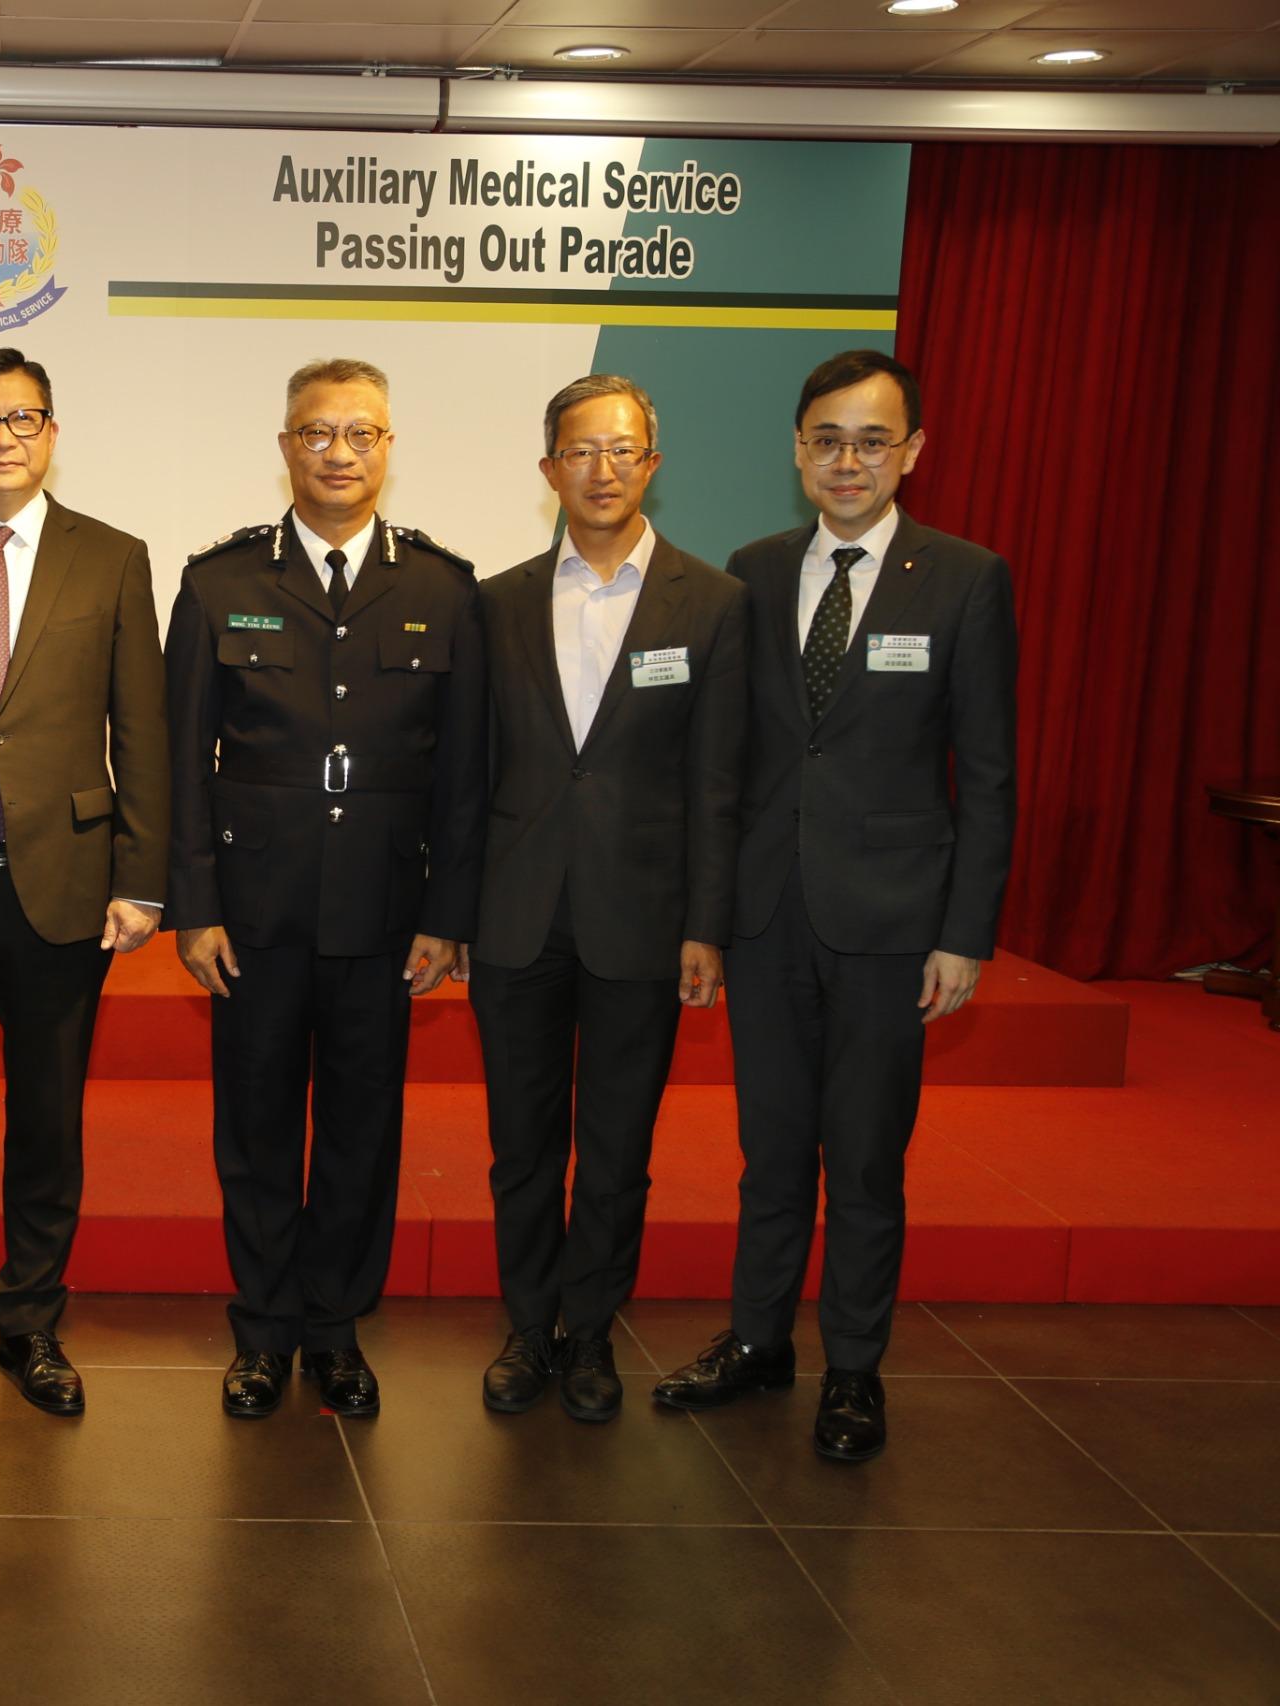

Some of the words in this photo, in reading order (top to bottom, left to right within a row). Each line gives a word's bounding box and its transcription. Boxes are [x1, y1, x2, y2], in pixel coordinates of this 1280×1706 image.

[273, 155, 437, 217] Auxiliary
[448, 158, 589, 209] Medical
[602, 161, 738, 213] Service
[316, 221, 465, 283] Passing
[479, 225, 546, 274] Out
[560, 228, 693, 277] Parade
[21, 291, 55, 319] SERVICE
